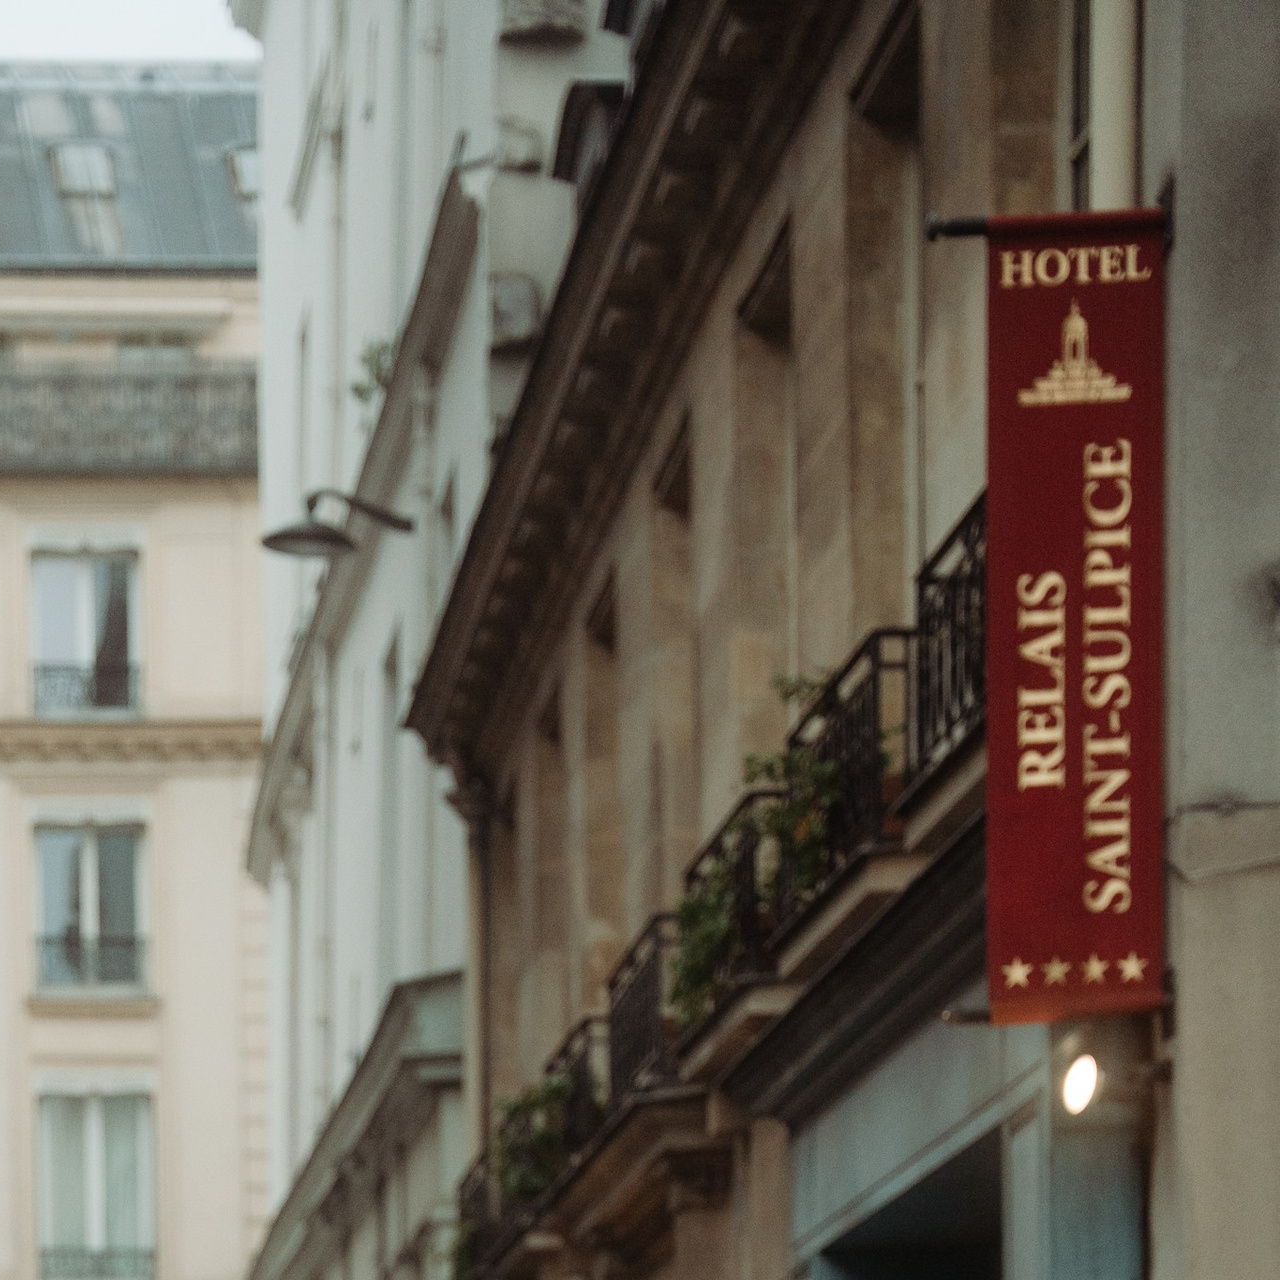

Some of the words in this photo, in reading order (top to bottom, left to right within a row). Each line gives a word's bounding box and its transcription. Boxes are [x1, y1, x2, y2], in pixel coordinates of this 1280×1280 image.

[1000, 244, 1152, 288] HOTEL
[1017, 570, 1066, 790] RELAIS
[1083, 438, 1132, 914] SAINT-SULPICE
